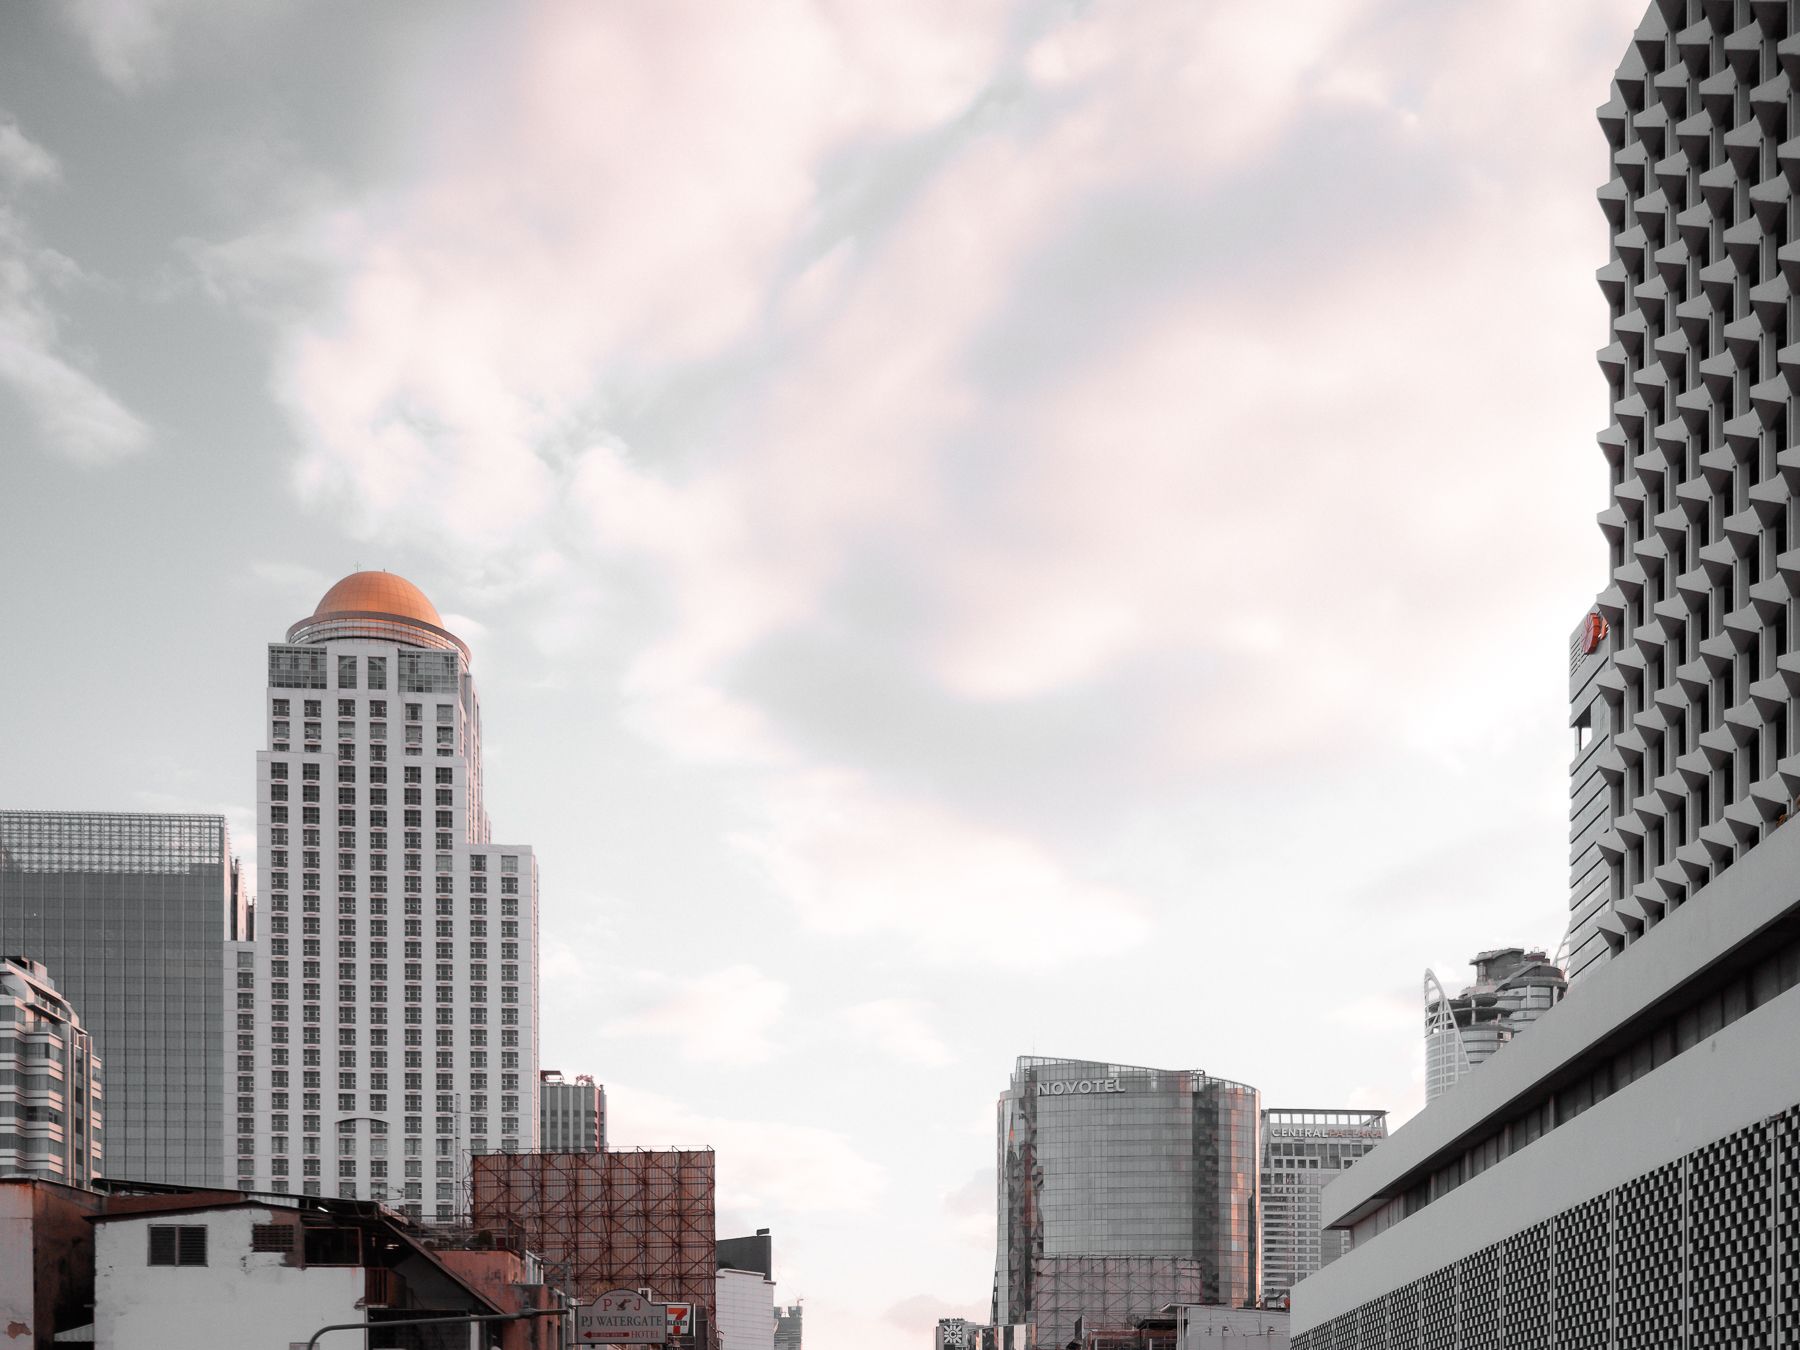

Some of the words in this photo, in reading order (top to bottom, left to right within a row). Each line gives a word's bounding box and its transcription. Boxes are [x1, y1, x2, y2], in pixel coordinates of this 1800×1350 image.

[1038, 1079, 1126, 1096] NOVOTEL
[581, 1316, 593, 1327] PJ
[597, 1315, 662, 1327] WATERGATE
[631, 1330, 659, 1339] HOTEL
